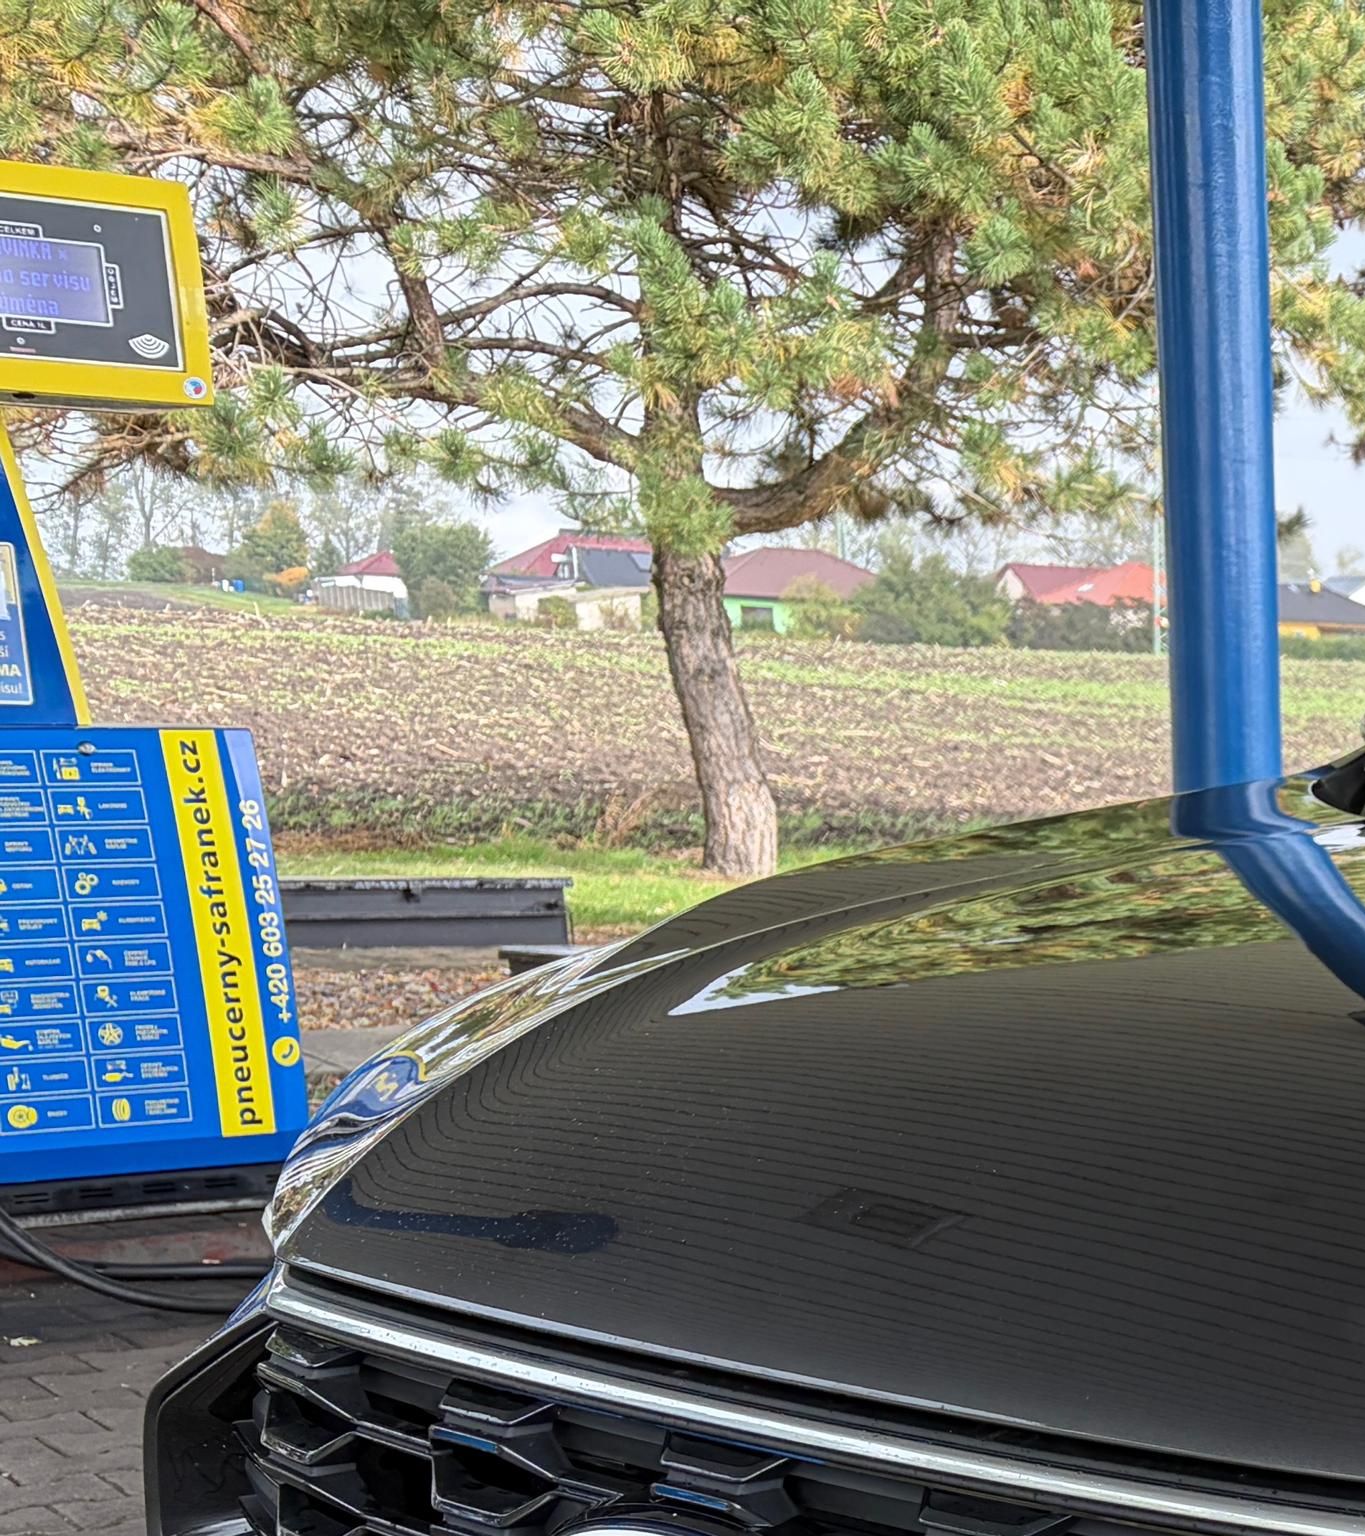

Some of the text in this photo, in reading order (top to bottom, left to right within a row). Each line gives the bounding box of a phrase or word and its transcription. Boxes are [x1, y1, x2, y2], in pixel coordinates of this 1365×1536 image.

[0, 236, 51, 260] VINKA
[179, 738, 262, 1126] pneucerny-safranek.cz
[240, 799, 292, 1023] +420 603 25 27 26
